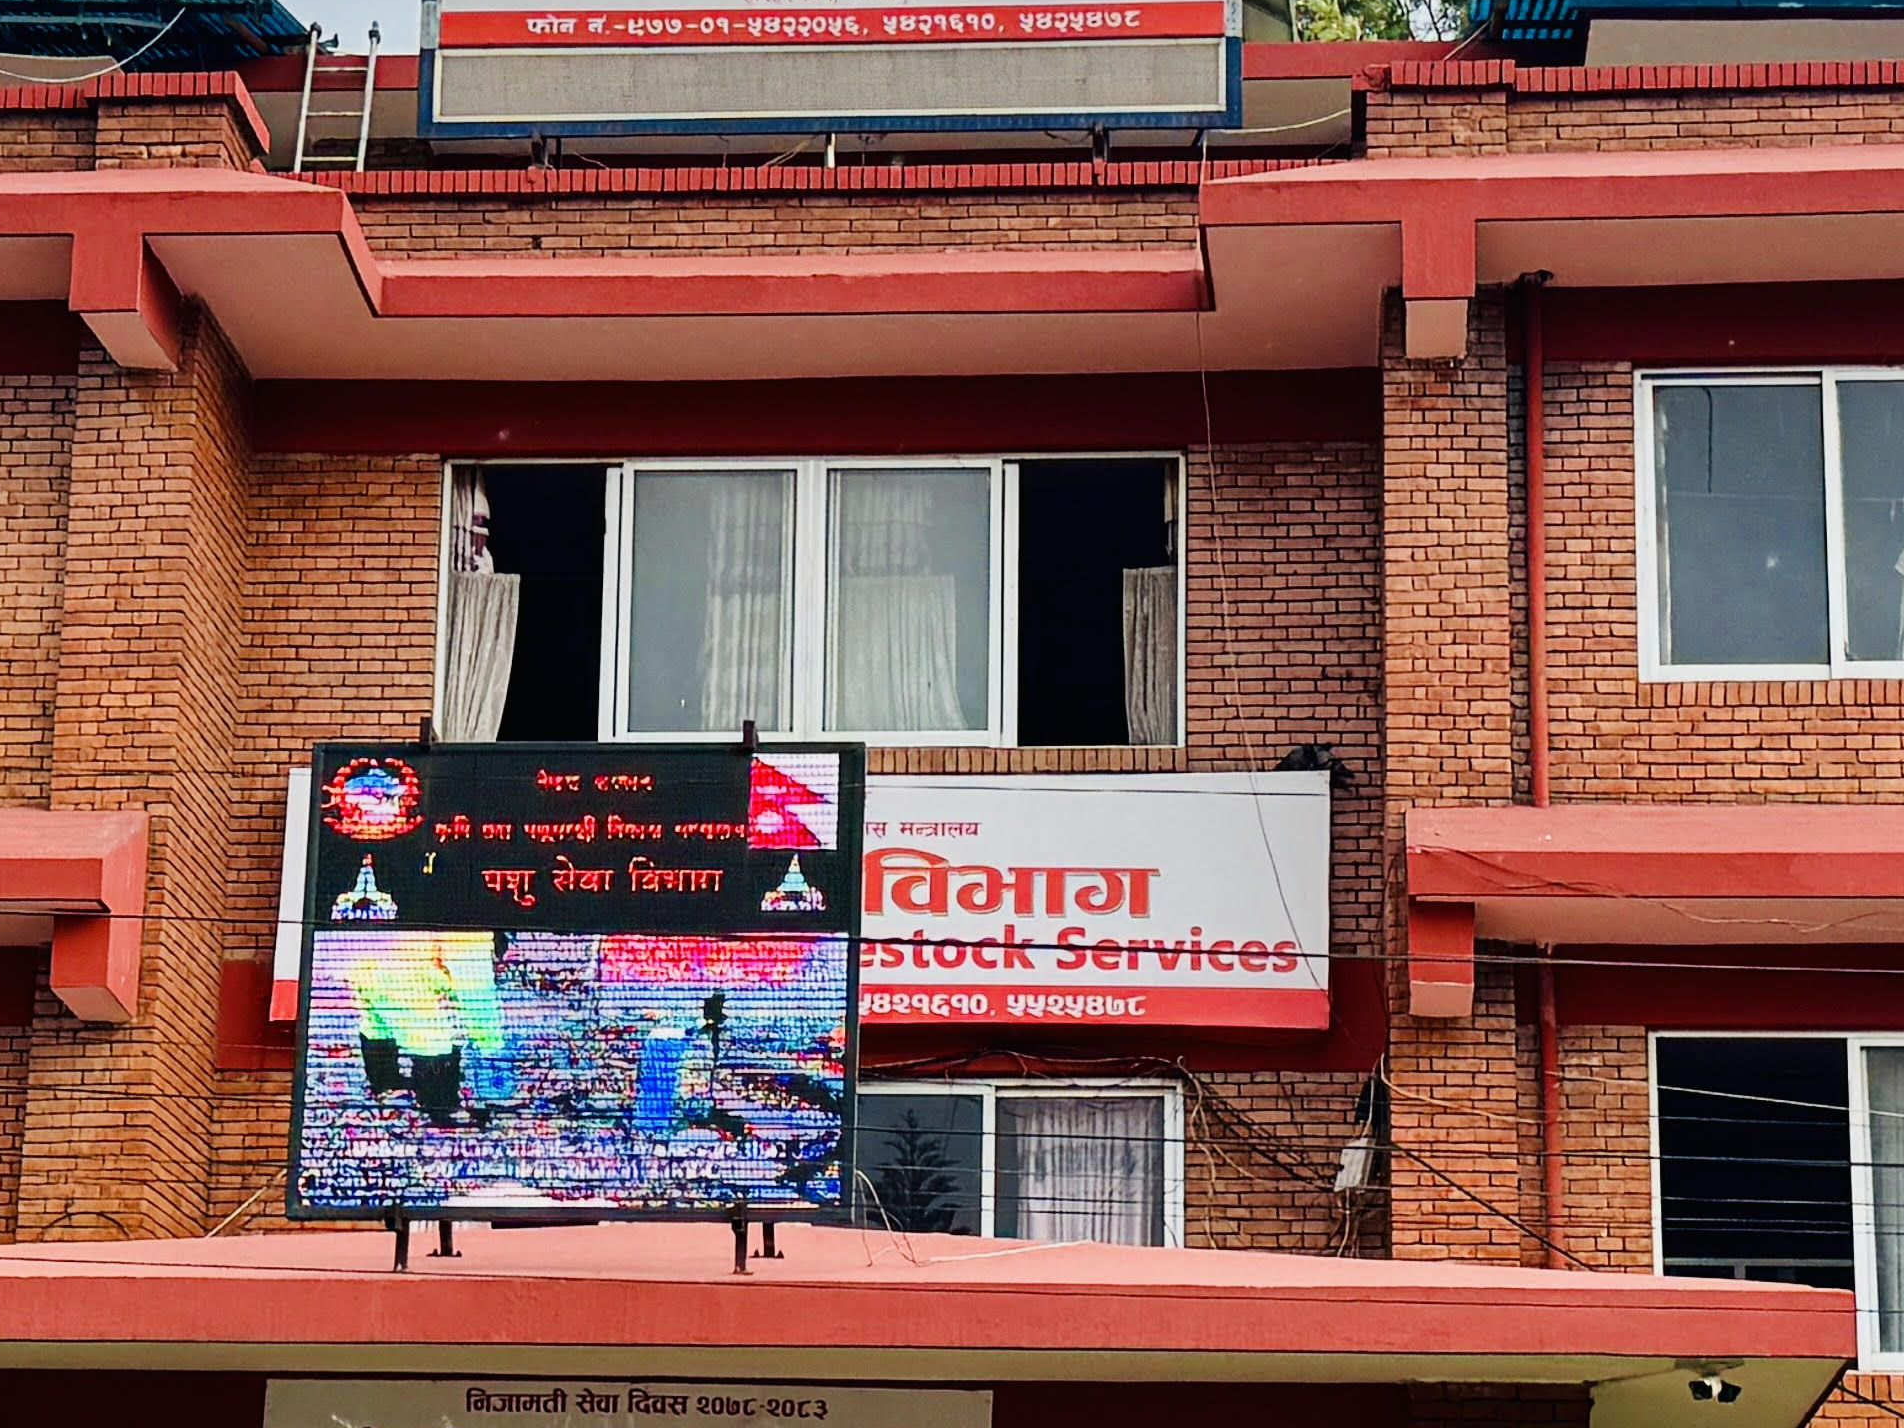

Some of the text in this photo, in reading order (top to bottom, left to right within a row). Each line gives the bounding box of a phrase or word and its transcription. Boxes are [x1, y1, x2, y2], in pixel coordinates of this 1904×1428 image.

[527, 15, 577, 35] फोन
[899, 821, 982, 838] मन्त्रालय
[481, 855, 724, 906] पशु सेवा विभाग
[863, 847, 1160, 918] विभाग
[860, 924, 1299, 973] estock Services
[465, 1388, 568, 1414] निजामती
[575, 1388, 620, 1414] सेवा
[628, 1388, 690, 1416] दिवस
